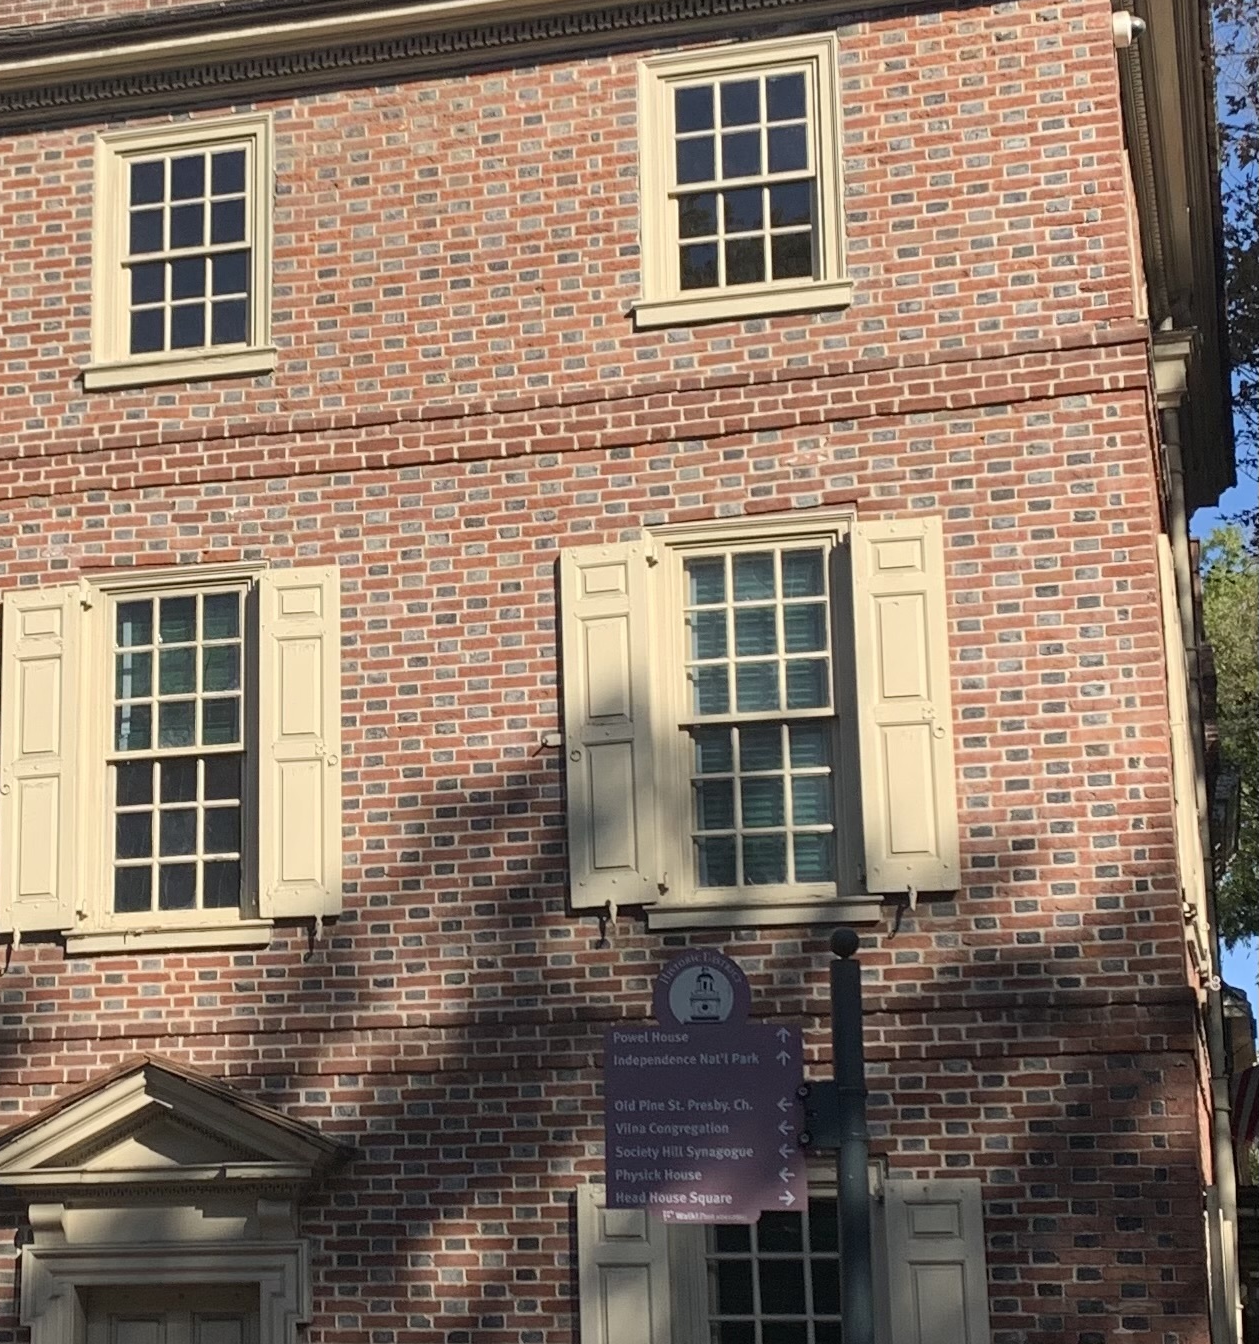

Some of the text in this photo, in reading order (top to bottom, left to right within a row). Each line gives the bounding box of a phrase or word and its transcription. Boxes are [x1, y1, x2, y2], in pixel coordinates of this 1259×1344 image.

[613, 1031, 689, 1043] Powel House
[613, 1052, 759, 1068] Independence Nat'l Park
[614, 1099, 754, 1113] Old Pine St. Presby. Ch.
[615, 1122, 730, 1137] Vilna Congregation
[615, 1146, 754, 1160] Society Hill Synagogue
[615, 1169, 703, 1183] Physick House
[615, 1191, 733, 1206] Head House Square
